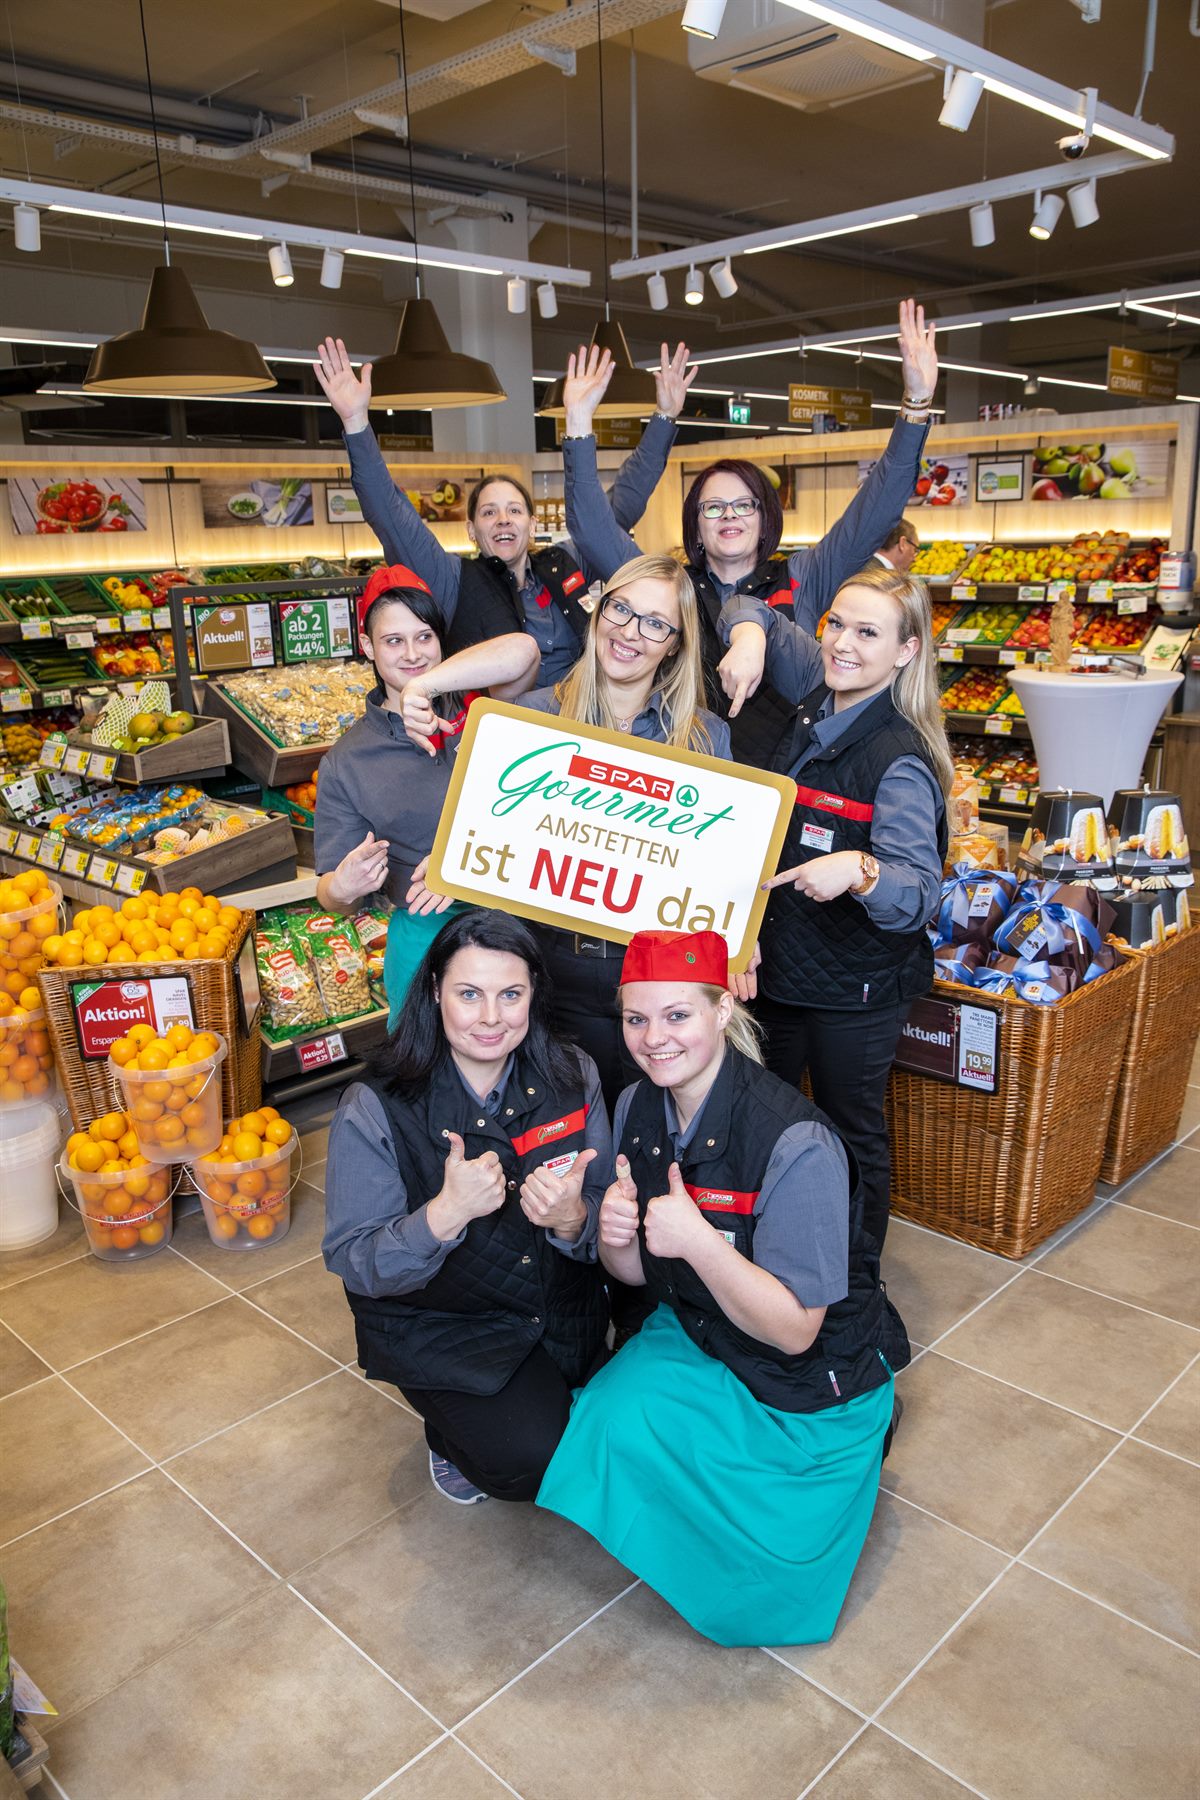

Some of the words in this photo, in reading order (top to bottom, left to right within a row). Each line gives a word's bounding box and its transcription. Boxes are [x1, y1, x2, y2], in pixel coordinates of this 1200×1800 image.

[793, 389, 829, 401] KOSMETIK
[197, 609, 210, 622] BIO
[282, 605, 294, 618] BIO
[289, 615, 308, 633] ab
[312, 613, 322, 631] 2
[203, 630, 245, 645] Aktuell!
[288, 631, 325, 641] Packungen
[289, 641, 325, 656] -44%
[589, 764, 671, 798] SPAR
[491, 742, 735, 840] Gourmet
[809, 827, 825, 837] SPAR
[536, 814, 679, 868] AMSTETTEN
[460, 830, 515, 883] ist
[529, 848, 643, 914] NEU
[657, 887, 735, 938] da!
[84, 1006, 145, 1023] Aktion!
[303, 1047, 326, 1060] Aktion!
[967, 1053, 992, 1070] 19.99
[962, 1068, 994, 1082] Aktuell!
[551, 1156, 571, 1167] SPAR
